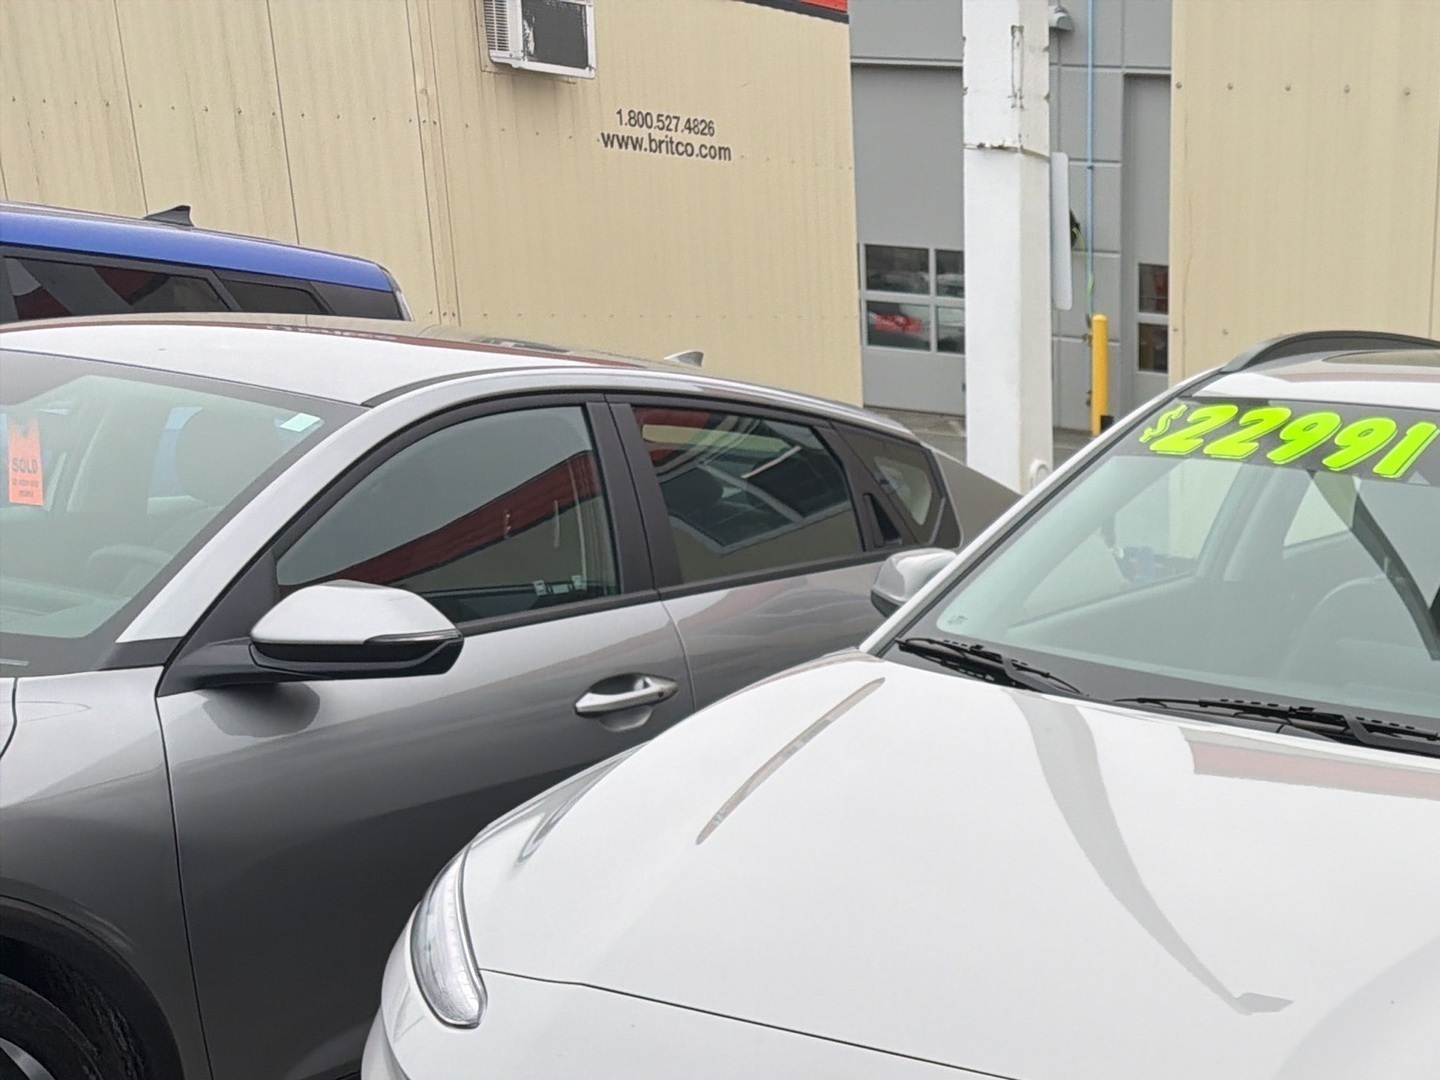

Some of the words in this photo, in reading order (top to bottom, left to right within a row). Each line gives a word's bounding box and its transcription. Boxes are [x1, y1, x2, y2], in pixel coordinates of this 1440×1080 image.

[616, 108, 715, 137] 1.800.527.4826
[600, 132, 732, 161] www.britco.com
[1139, 404, 1440, 478] $22991
[11, 457, 38, 475] SOLD
